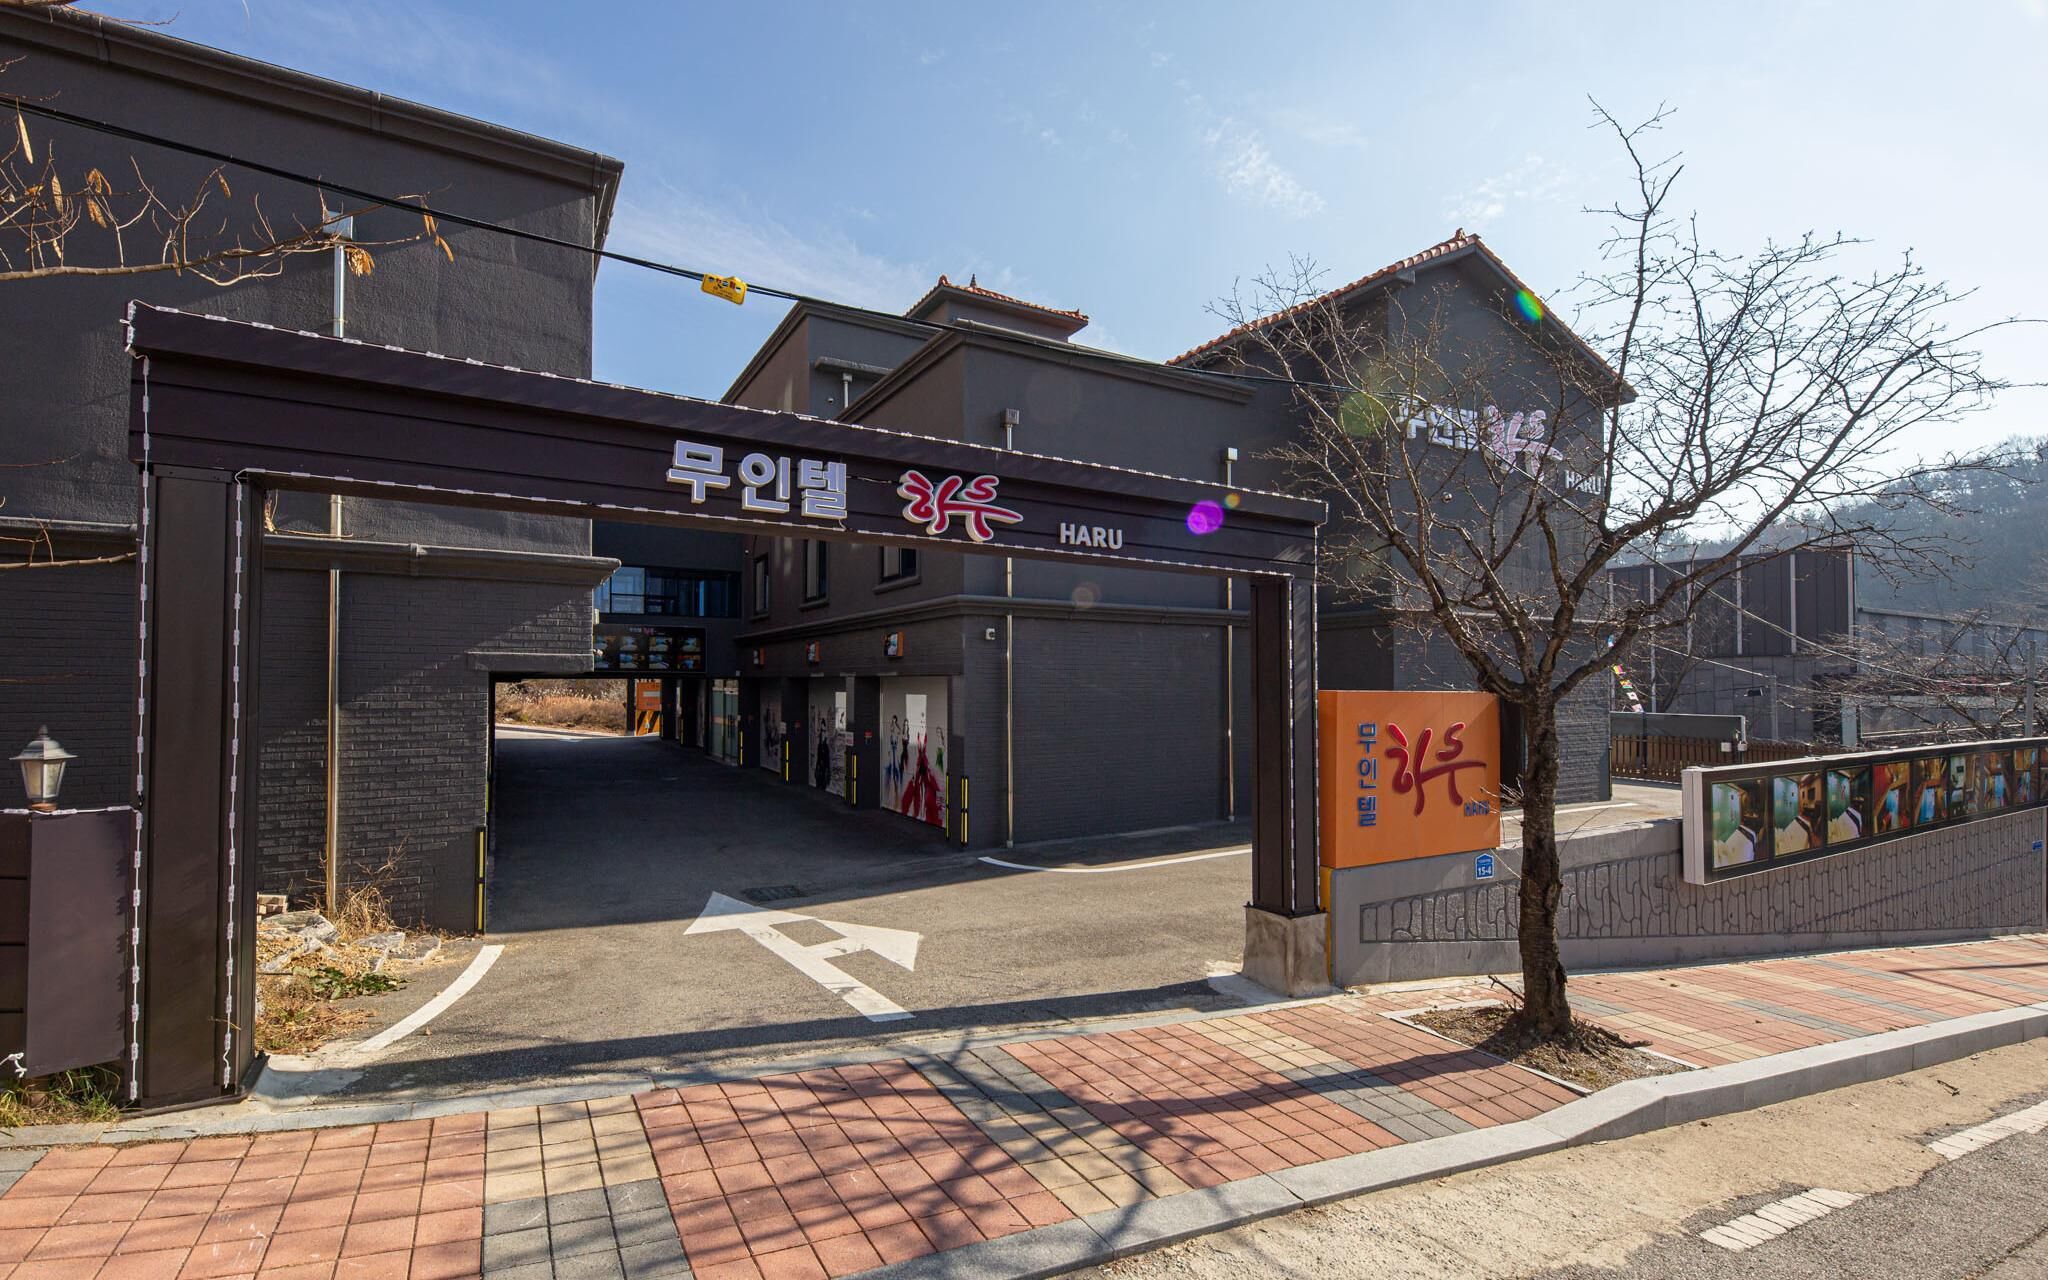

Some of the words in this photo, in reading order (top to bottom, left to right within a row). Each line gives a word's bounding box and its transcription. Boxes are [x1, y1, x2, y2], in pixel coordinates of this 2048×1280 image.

[666, 439, 848, 520] 무인텔
[897, 469, 1024, 542] 하루
[1059, 522, 1123, 549] HARU
[1564, 470, 1602, 495] HARU
[1357, 722, 1377, 827] 무인텔
[1384, 721, 1488, 817] 하루
